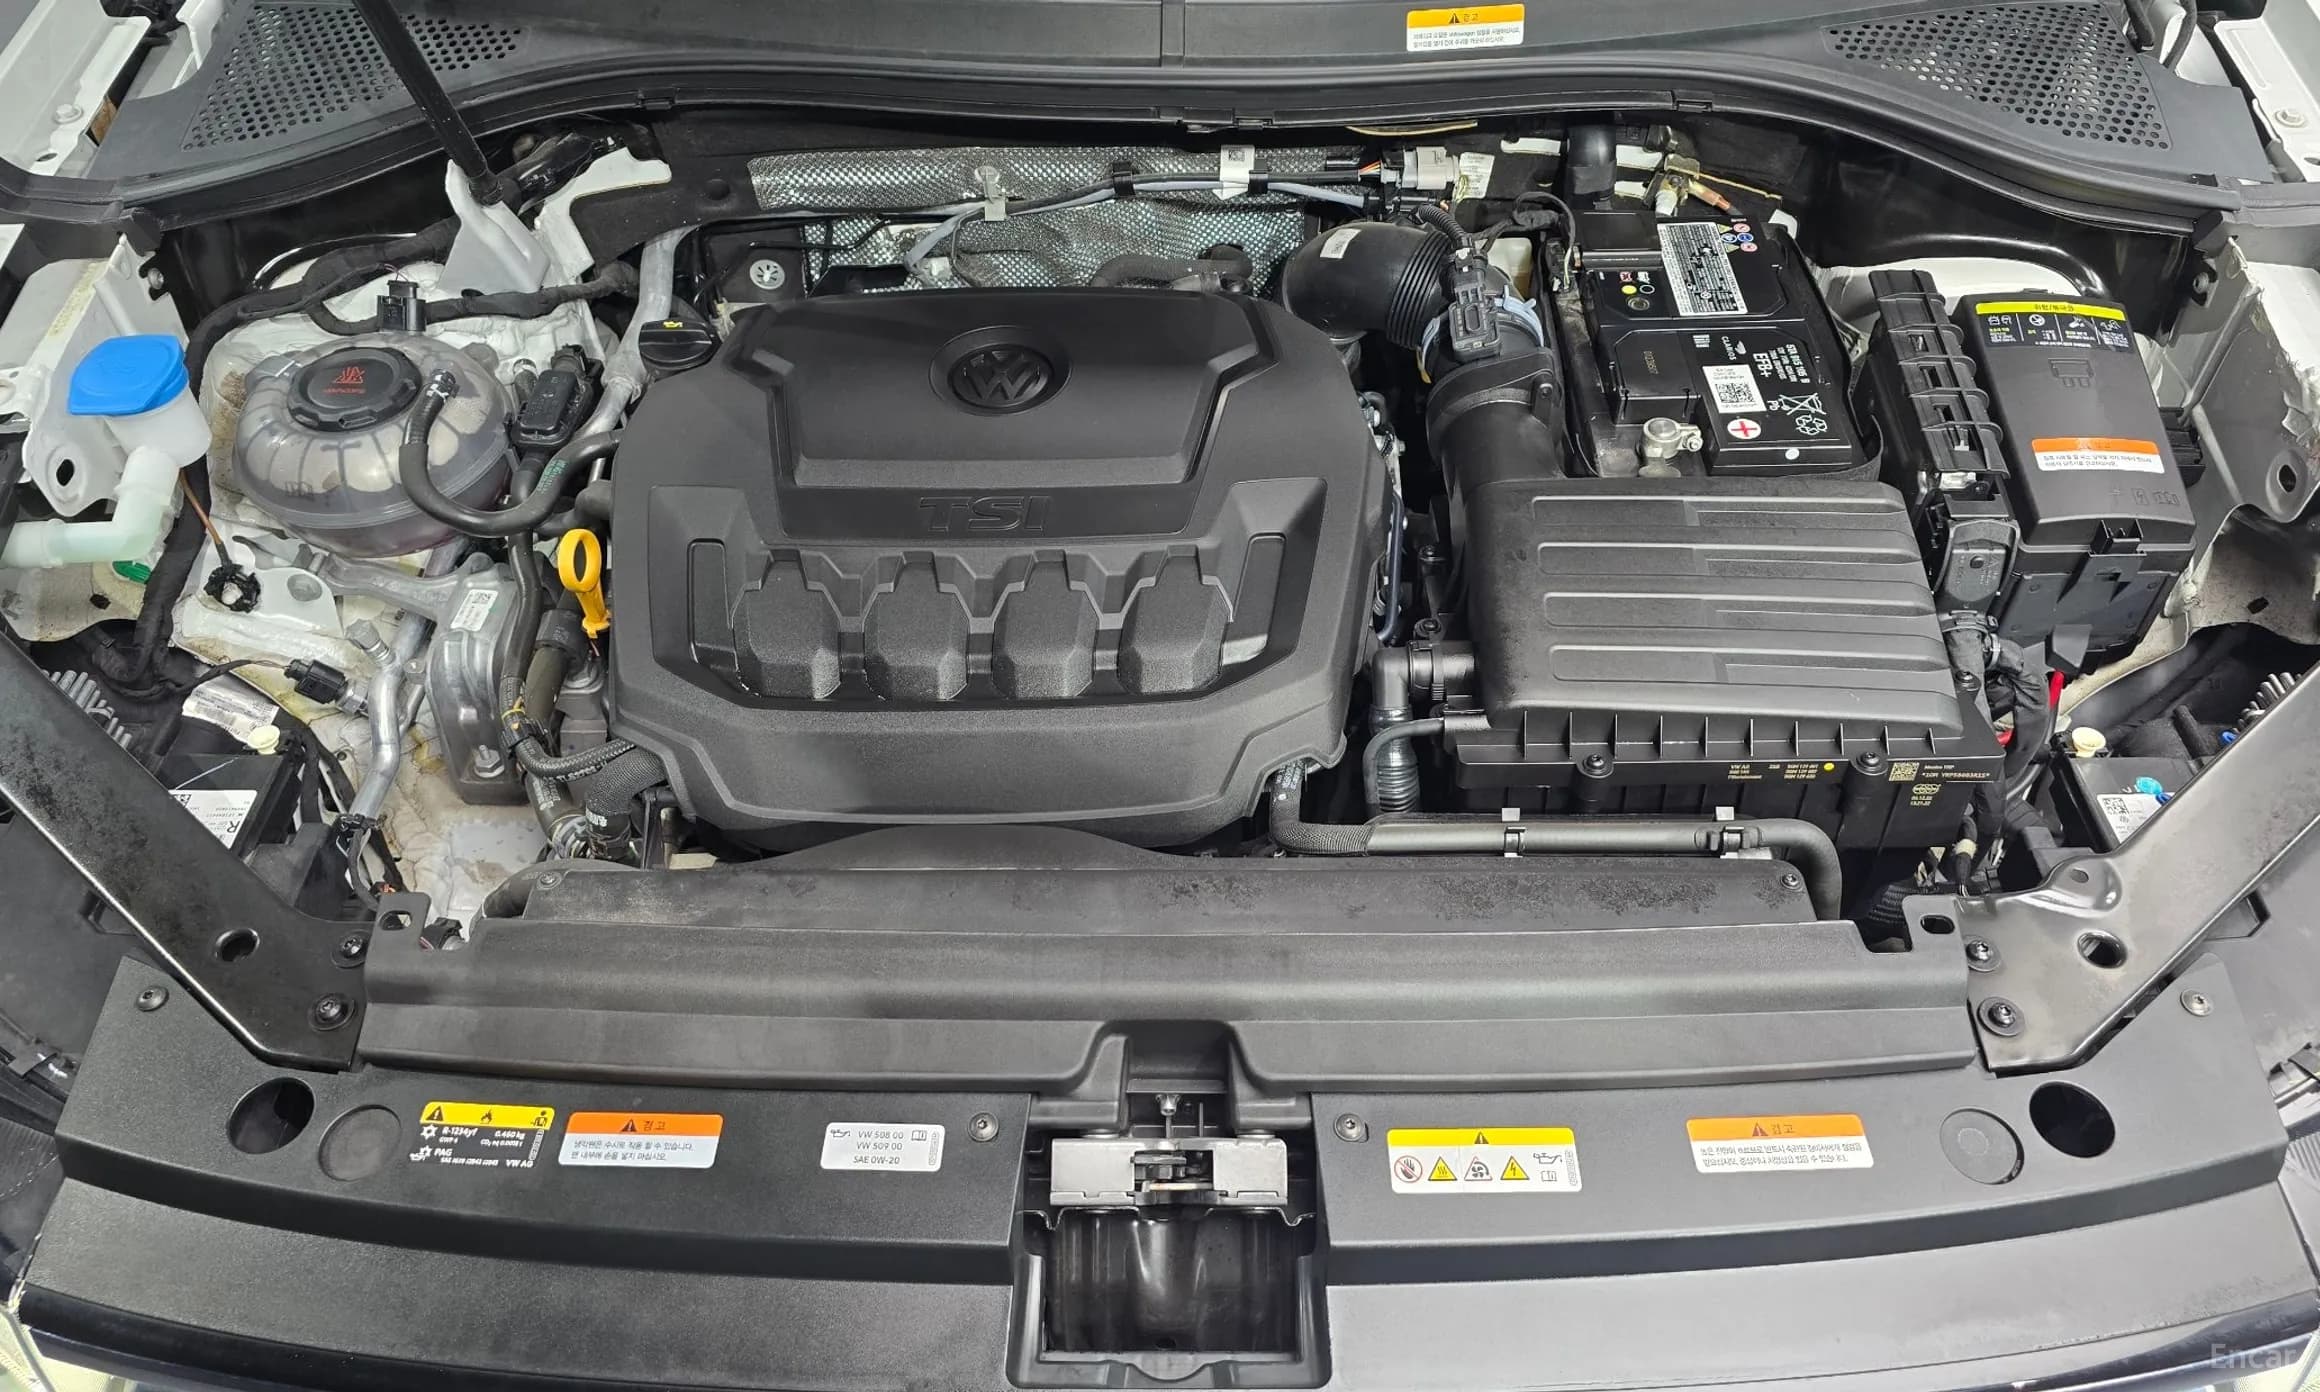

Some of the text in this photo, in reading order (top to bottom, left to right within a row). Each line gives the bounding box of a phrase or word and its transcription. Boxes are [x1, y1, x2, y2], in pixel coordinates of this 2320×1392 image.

[1721, 336, 1737, 361] CLARIOS
[1752, 353, 1773, 378] EFB+
[1766, 400, 1780, 411] Pb
[920, 496, 1051, 533] TSI
[643, 1120, 666, 1132] 경고
[442, 1126, 478, 1138] R-1234yf
[858, 1131, 904, 1139] VW 508 00
[604, 1140, 625, 1149] 수시로
[856, 1142, 903, 1150] VW 509 00
[434, 1148, 453, 1156] PAG
[506, 1159, 534, 1168] VW AG
[853, 1156, 900, 1165] SAE 0W-20
